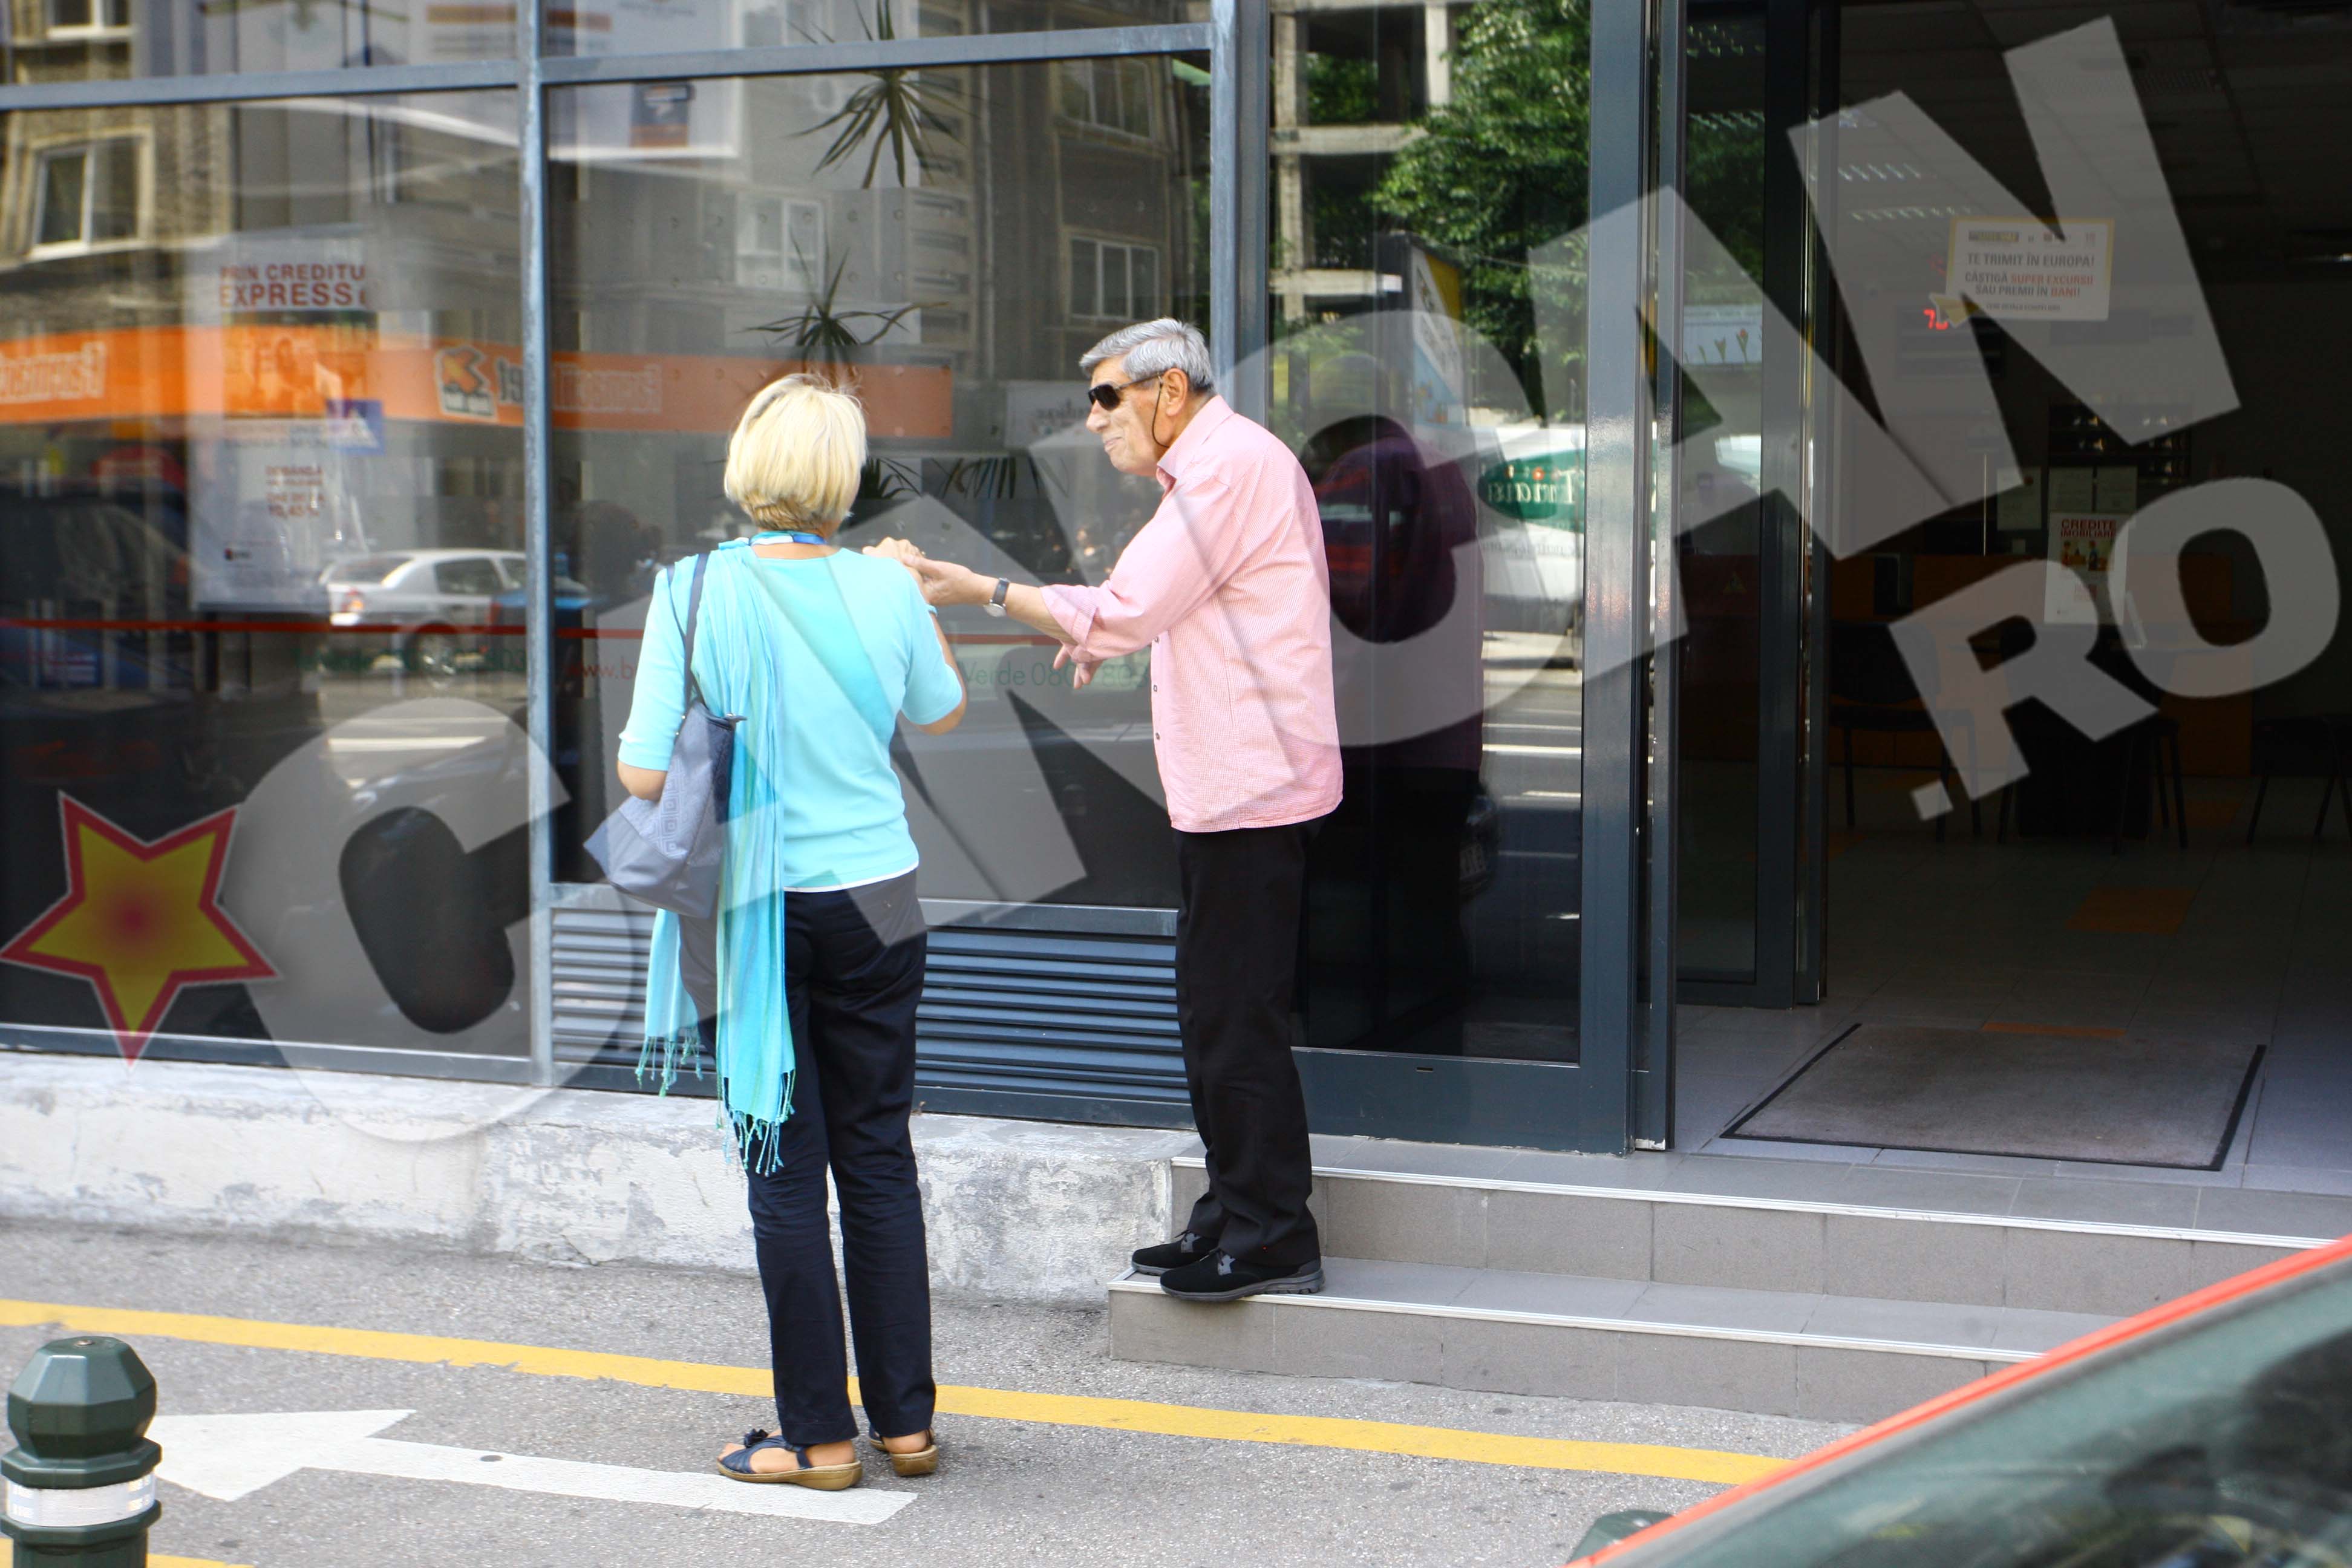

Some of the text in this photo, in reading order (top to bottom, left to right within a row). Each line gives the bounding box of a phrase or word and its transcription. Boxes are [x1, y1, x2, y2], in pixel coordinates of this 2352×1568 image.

[1967, 253, 1981, 265] TE
[1984, 253, 2024, 266] TRIMIT
[2043, 253, 2096, 267] EUROPA!
[2011, 273, 2043, 285] SUPER
[220, 283, 353, 307] EXPRESS
[1976, 285, 1996, 295] SAU
[2060, 518, 2116, 529] CREDITE
